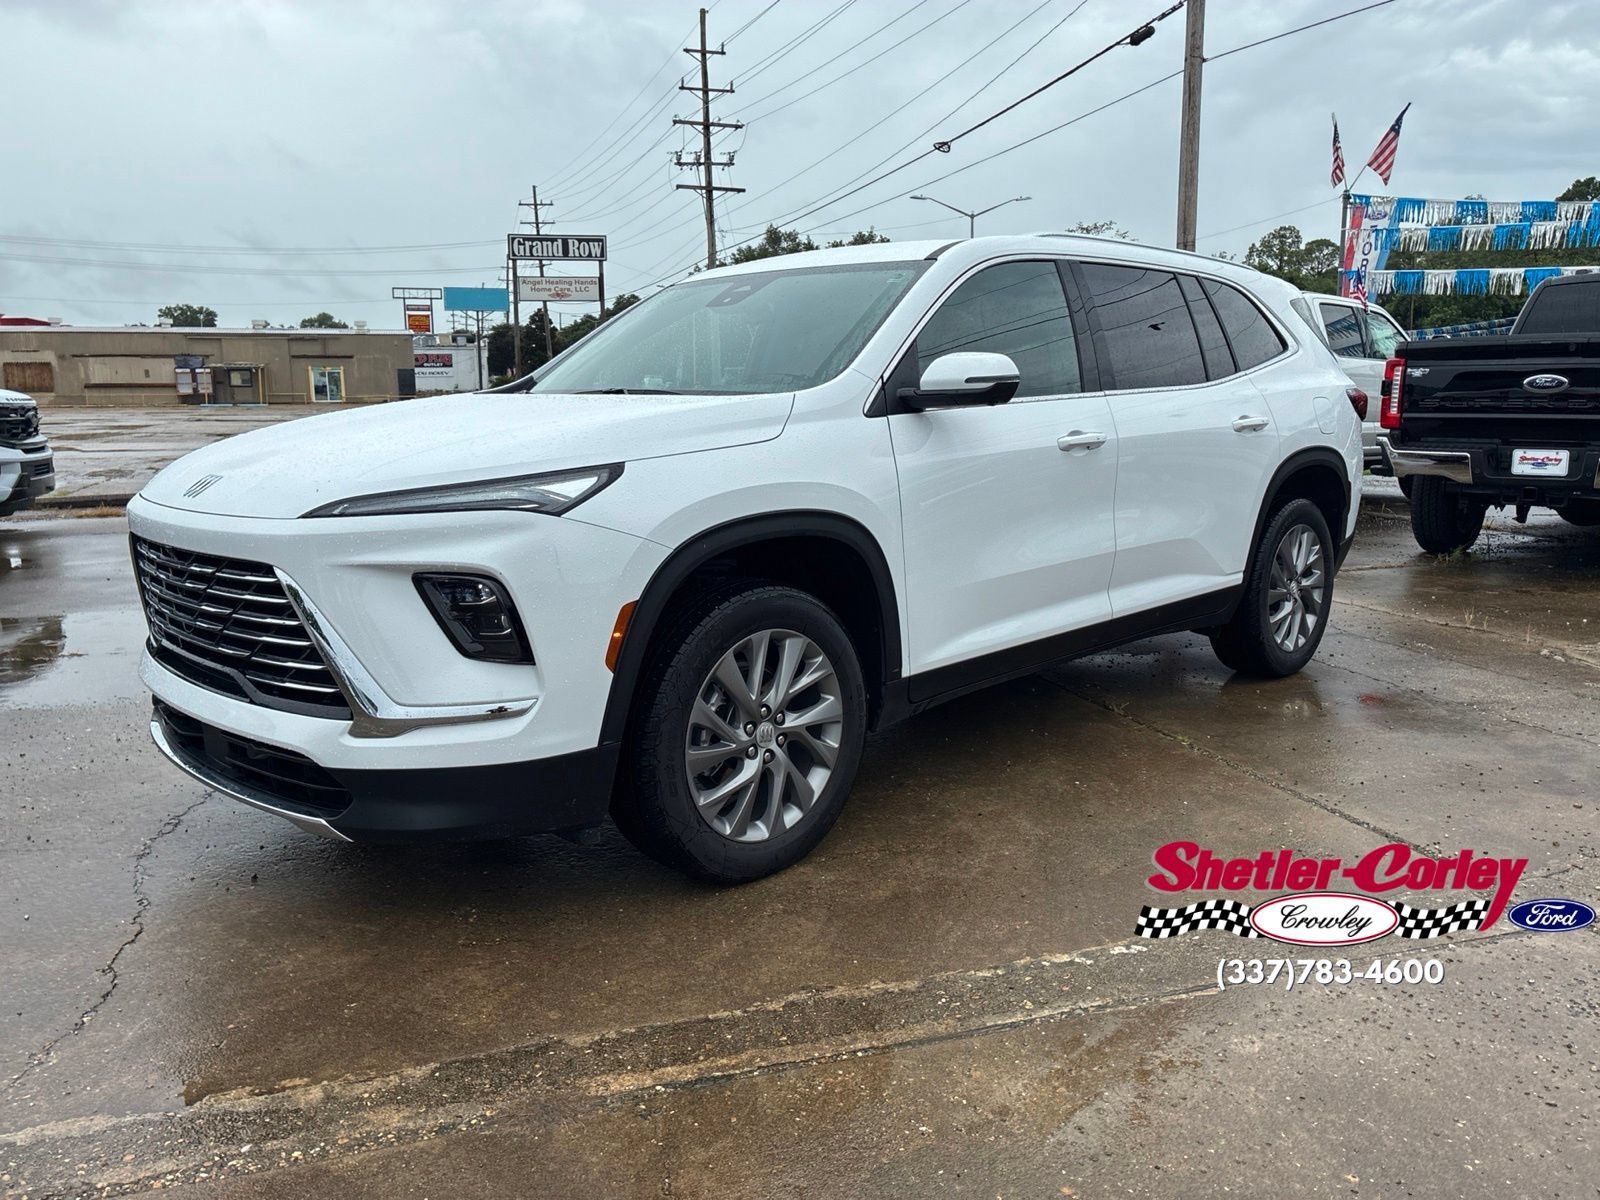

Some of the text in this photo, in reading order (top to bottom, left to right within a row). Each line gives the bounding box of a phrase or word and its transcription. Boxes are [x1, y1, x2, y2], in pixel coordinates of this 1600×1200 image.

[512, 237, 603, 258] Grand Row
[1533, 377, 1558, 388] Ford
